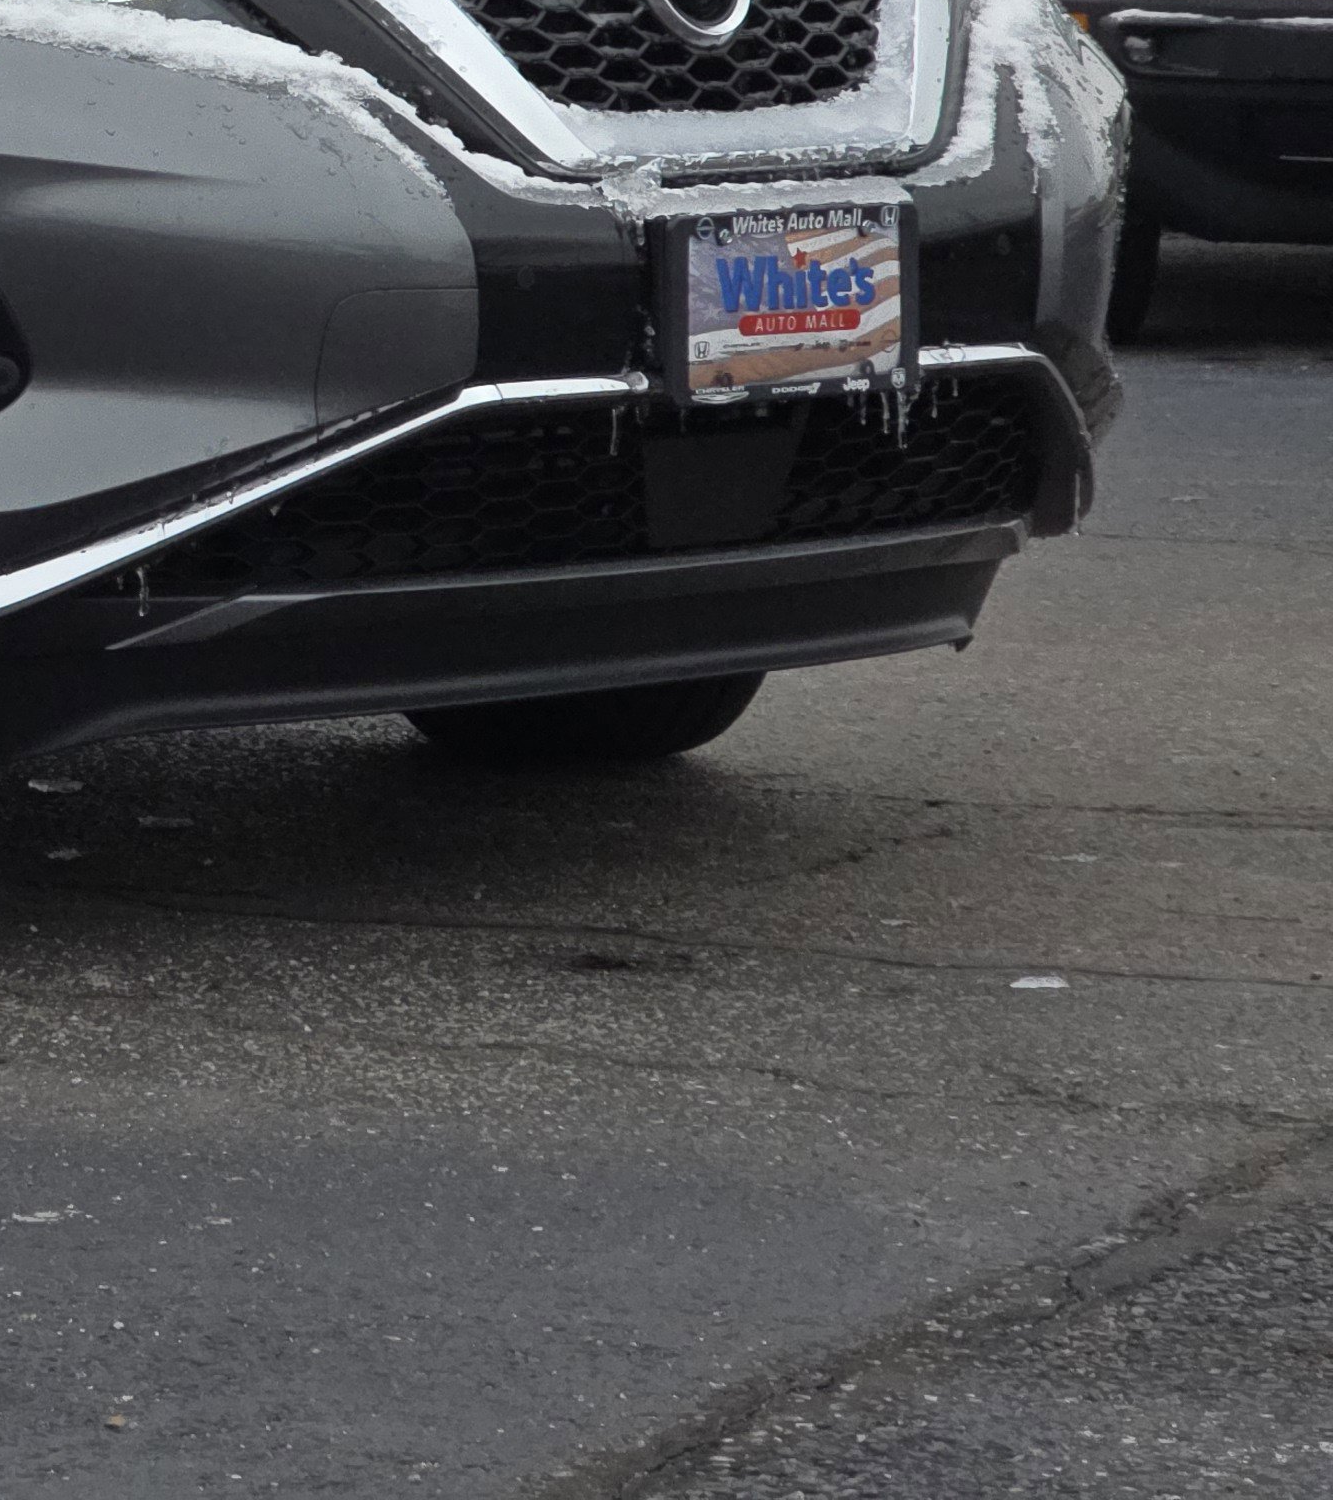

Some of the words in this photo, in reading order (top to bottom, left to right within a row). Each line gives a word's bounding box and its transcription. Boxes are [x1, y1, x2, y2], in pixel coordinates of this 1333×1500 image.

[732, 214, 784, 235] White's
[787, 212, 824, 231] Auto
[827, 208, 863, 228] Mall
[715, 255, 876, 313] White's
[755, 316, 797, 333] AUTO
[805, 313, 846, 329] MALL
[842, 376, 870, 392] Jeep
